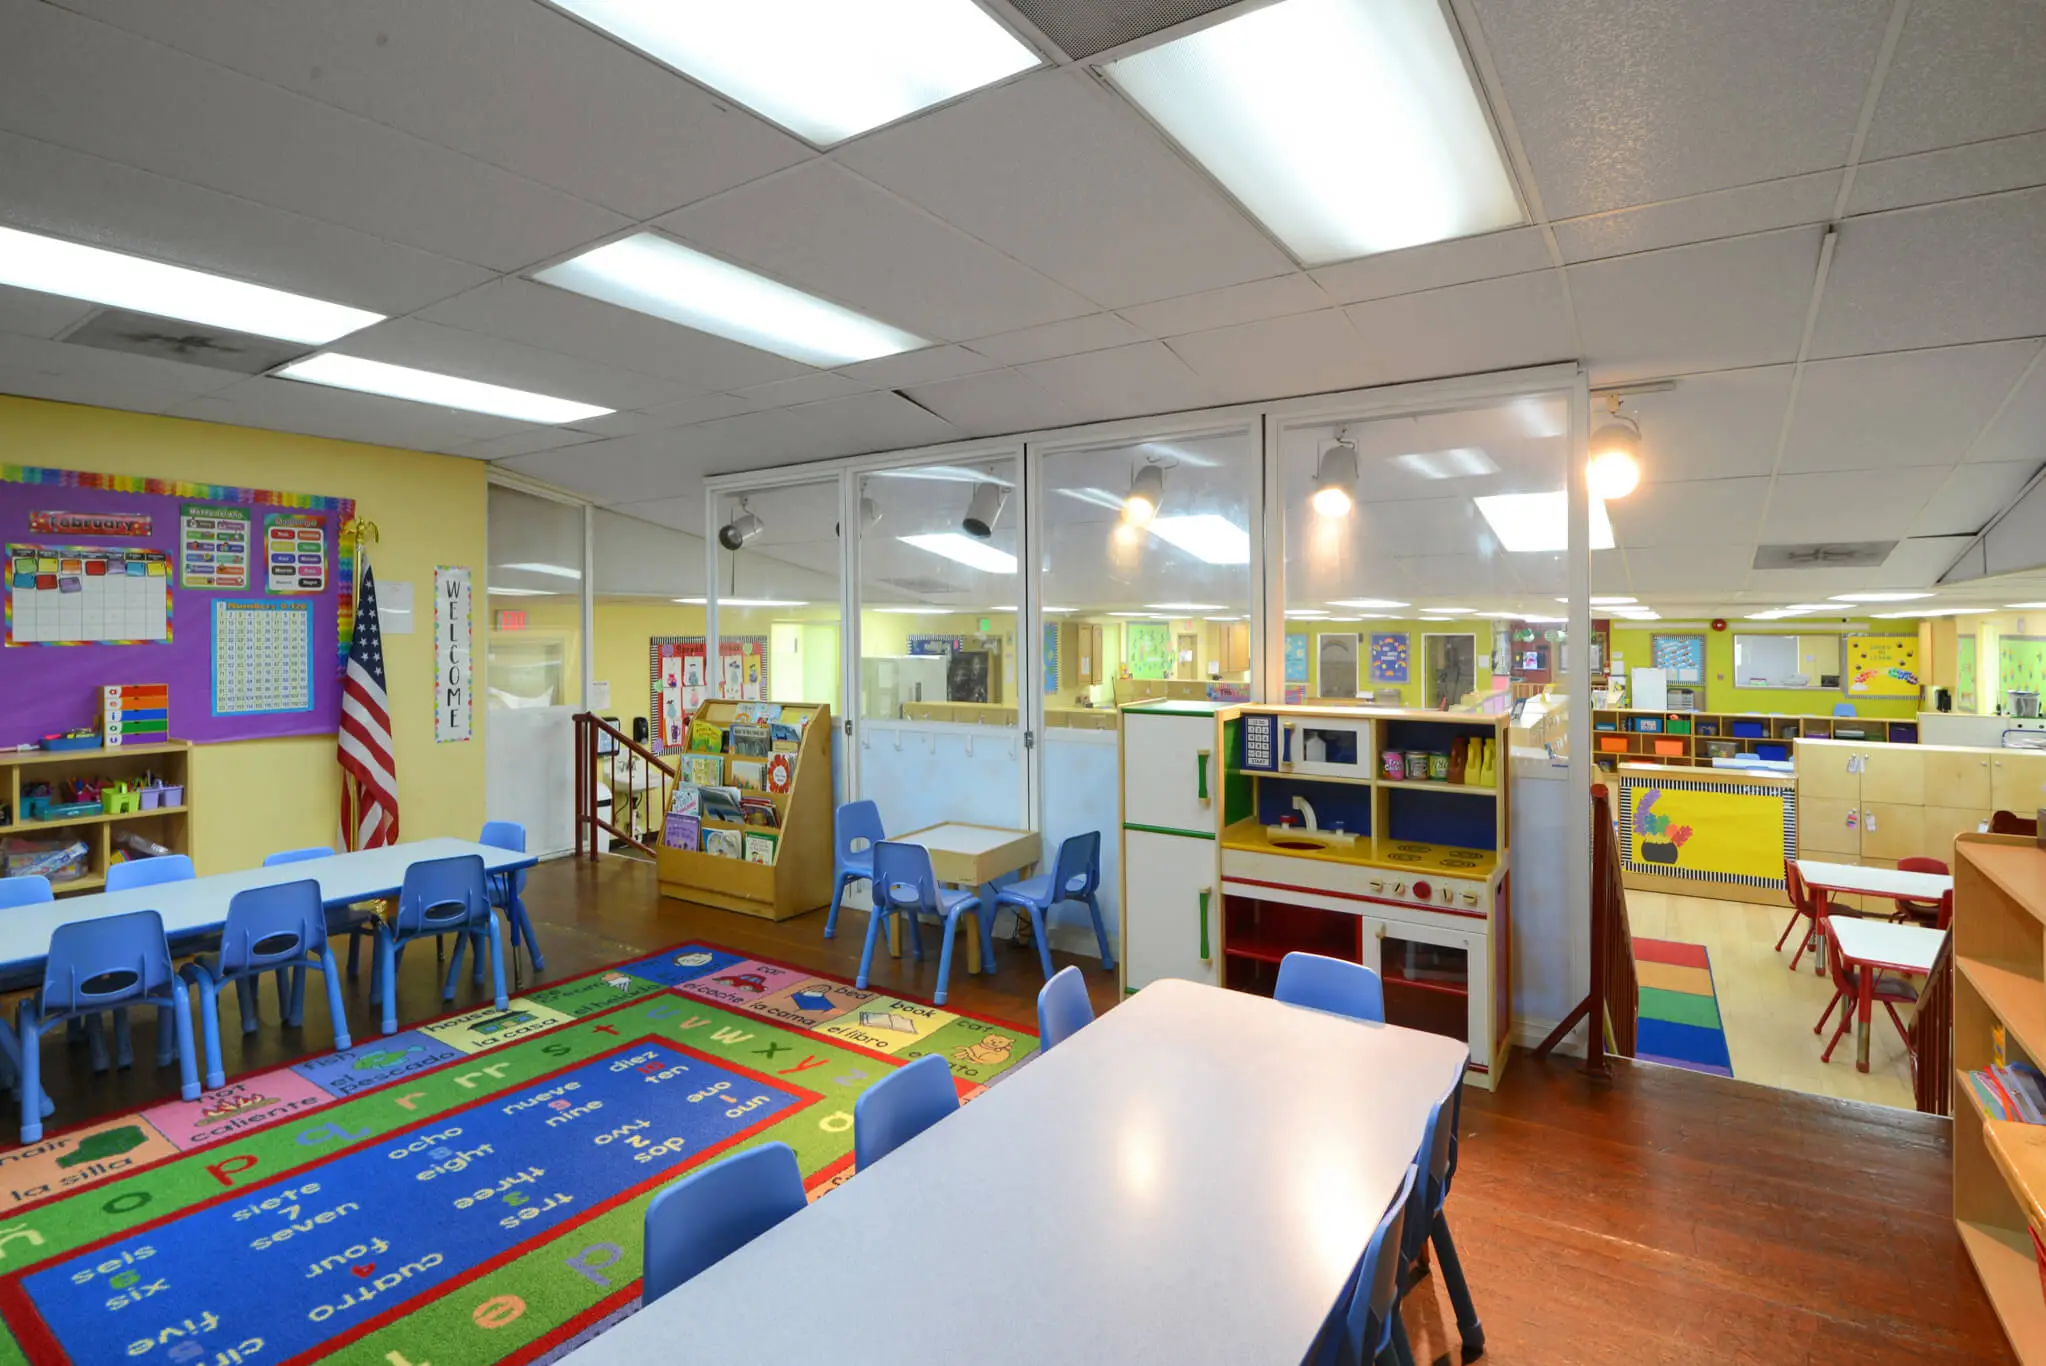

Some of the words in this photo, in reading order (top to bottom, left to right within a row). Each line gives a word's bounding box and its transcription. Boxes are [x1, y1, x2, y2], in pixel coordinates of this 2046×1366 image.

[50, 515, 135, 531] February
[446, 580, 462, 728] WELCOME
[755, 965, 786, 976] car
[831, 985, 874, 1001] bed
[767, 1007, 817, 1027] cama
[888, 999, 938, 1020] book
[471, 1037, 501, 1047] la
[503, 1016, 559, 1041] casa
[827, 1024, 846, 1036] el
[844, 1028, 890, 1049] libro
[957, 1020, 995, 1032] cat
[678, 1015, 713, 1032] v
[709, 1025, 756, 1046] w
[752, 1041, 793, 1060] x
[777, 1054, 831, 1076] y
[303, 1050, 357, 1071] fish
[338, 1051, 456, 1096] pescado
[608, 1050, 660, 1073] diez
[637, 1061, 666, 1074] 10
[644, 1064, 689, 1085] ten
[949, 1062, 979, 1076] to
[201, 1083, 248, 1102] ot
[330, 1074, 355, 1088] el
[686, 1081, 731, 1104] one
[205, 1153, 259, 1187] p
[296, 1122, 372, 1146] q
[395, 1092, 427, 1110] r
[453, 1061, 512, 1088] rr
[541, 1043, 573, 1057] s
[592, 1023, 620, 1036] t
[502, 1081, 582, 1116] nueve
[724, 1095, 772, 1119] uno
[190, 1096, 318, 1142] caliente
[545, 1100, 604, 1128] nine
[388, 1127, 463, 1160] ocho
[594, 1118, 652, 1146] two
[0, 1138, 72, 1167] air
[416, 1143, 494, 1181] eight
[633, 1136, 685, 1164] dos
[11, 1184, 51, 1202] la
[59, 1157, 133, 1186] silla
[453, 1166, 545, 1210] three
[231, 1182, 321, 1222] siete
[278, 1204, 301, 1221] 7
[499, 1192, 574, 1229] tres
[249, 1202, 361, 1250] seven
[71, 1245, 157, 1285] seis
[305, 1237, 390, 1279] four
[105, 1278, 171, 1312] six
[308, 1252, 444, 1322] cuatro
[127, 1311, 219, 1356] five
